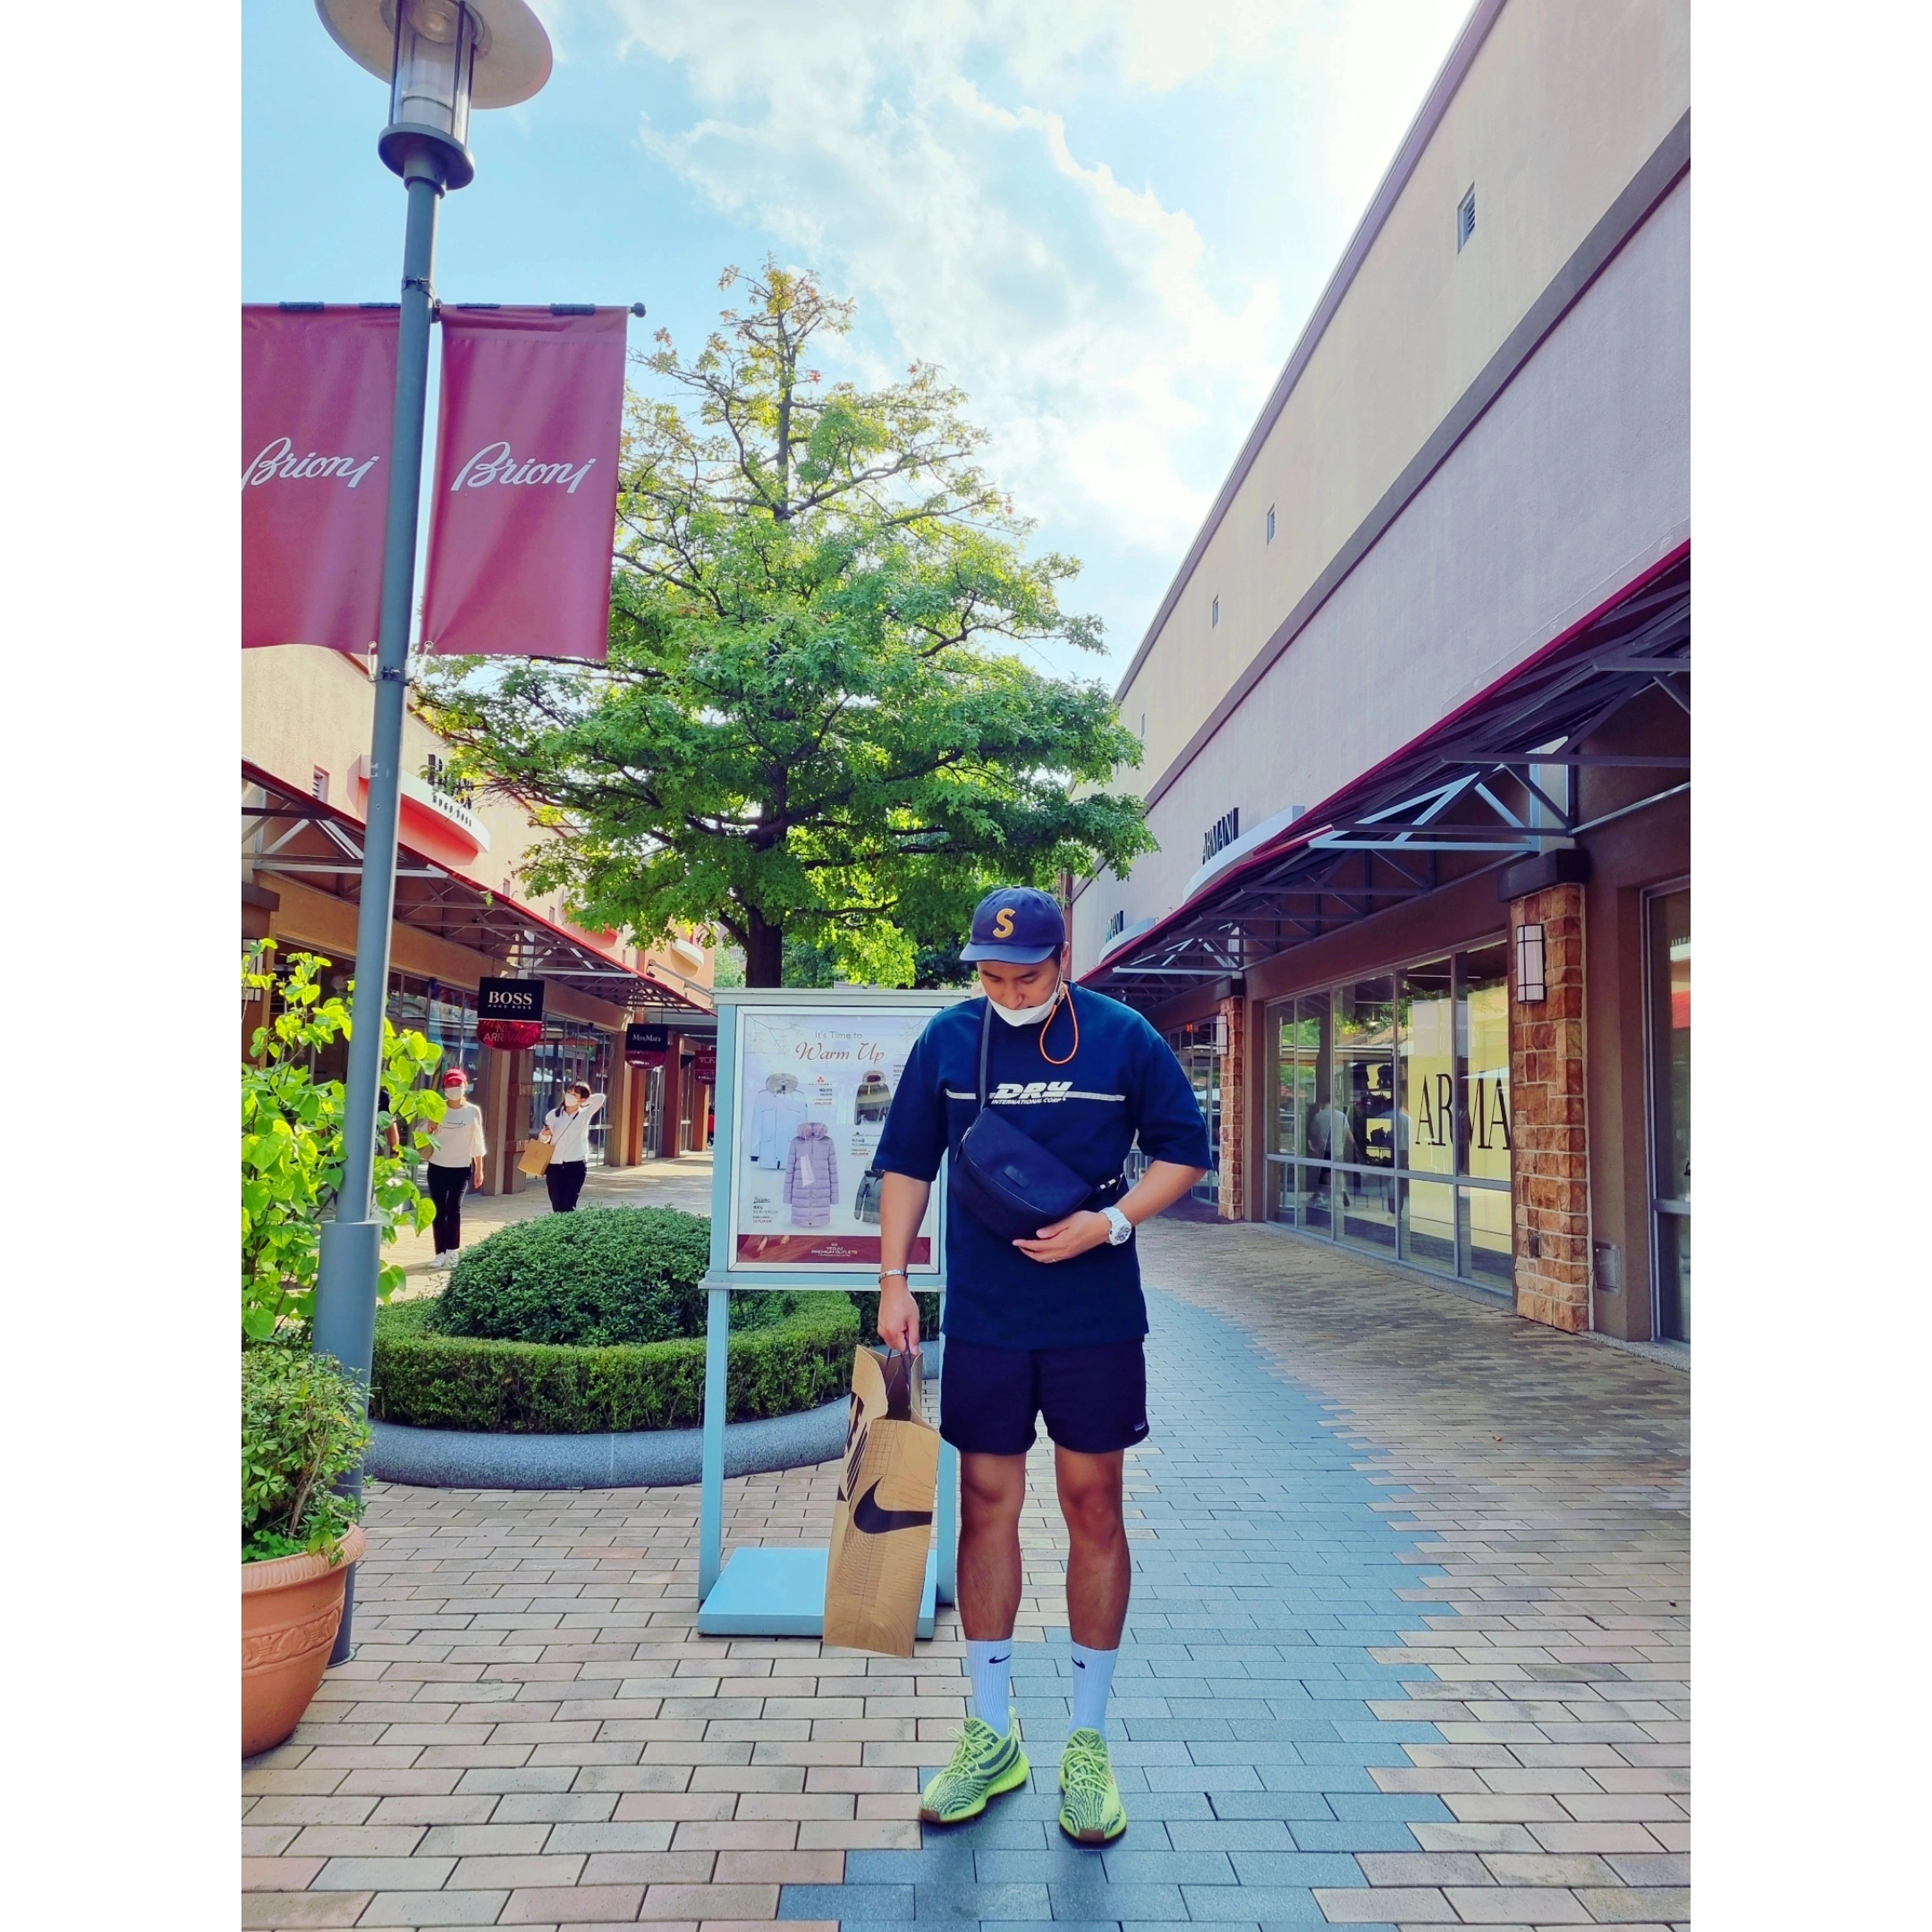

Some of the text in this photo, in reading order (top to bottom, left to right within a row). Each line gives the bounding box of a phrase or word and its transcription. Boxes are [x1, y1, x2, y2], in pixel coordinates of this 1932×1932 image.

[242, 437, 380, 491] Brioni
[450, 441, 596, 494] Brioni
[992, 908, 1016, 939] S
[488, 991, 533, 1005] BOSS
[632, 1033, 661, 1042] MaxMara
[815, 1030, 828, 1039] It's
[829, 1030, 852, 1039] Time
[795, 1042, 885, 1064] Warm Up
[993, 1081, 1073, 1100] DRY
